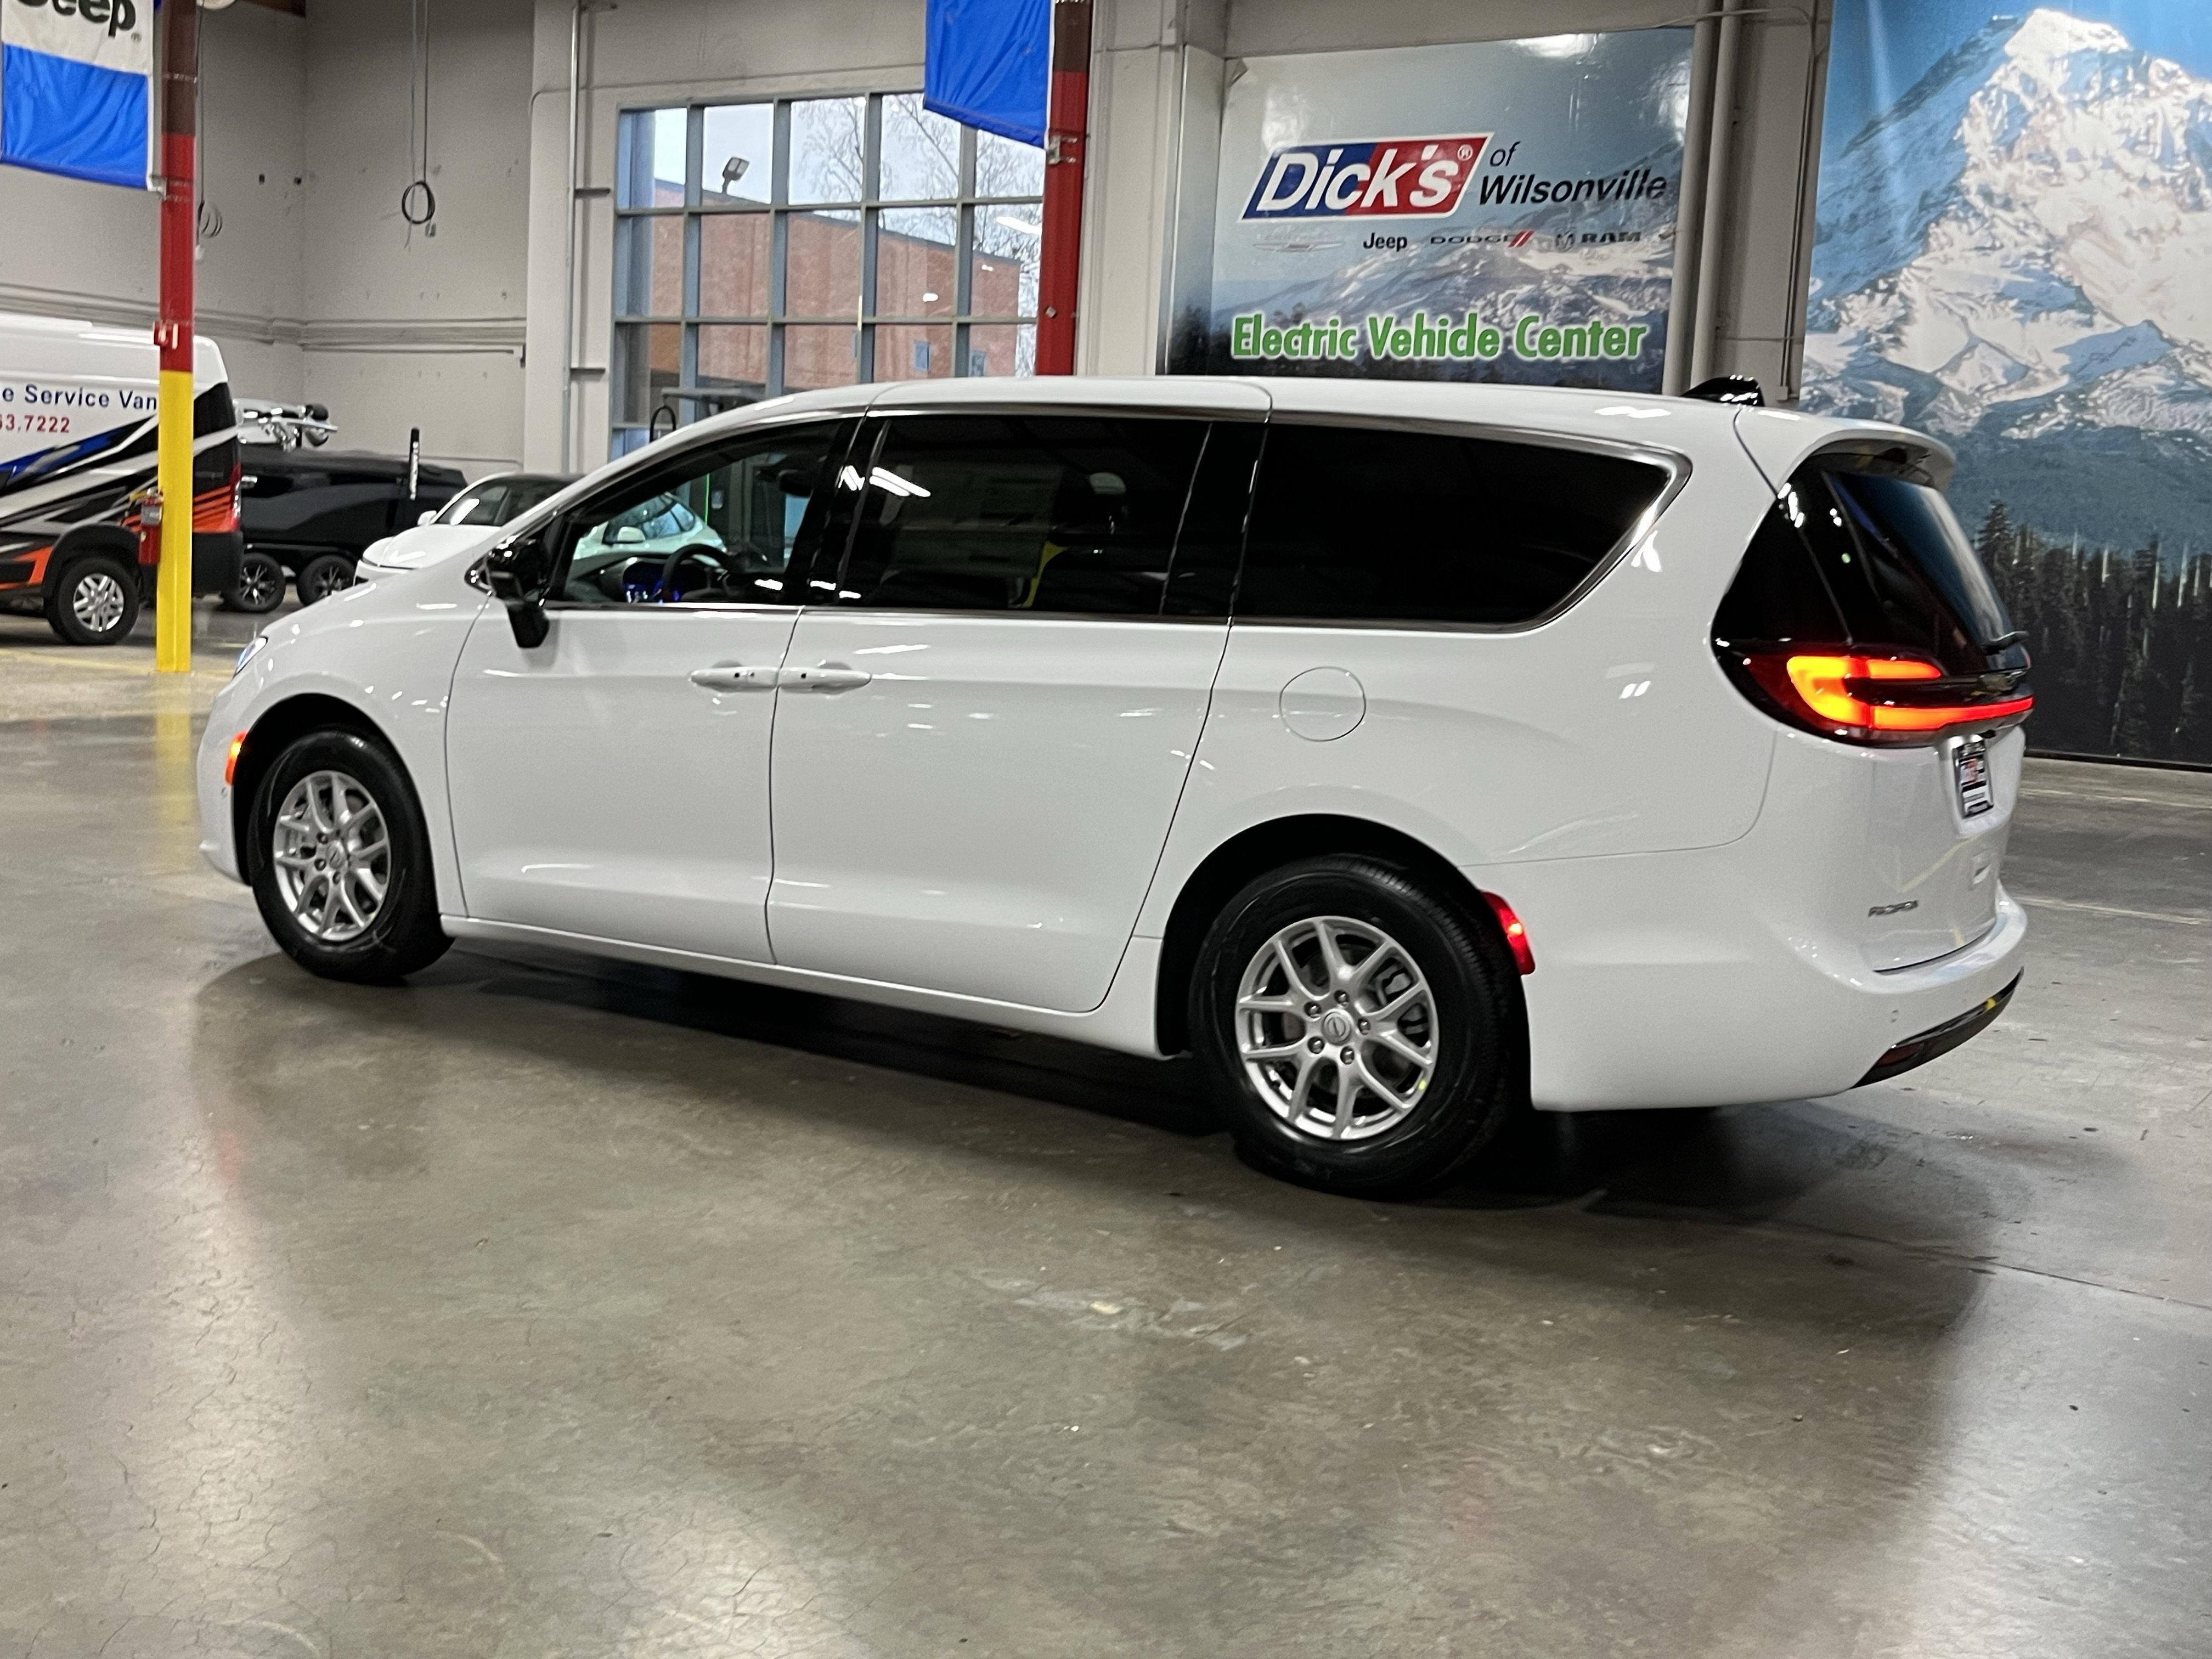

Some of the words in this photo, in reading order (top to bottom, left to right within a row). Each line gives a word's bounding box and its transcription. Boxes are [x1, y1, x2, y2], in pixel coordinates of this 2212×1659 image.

[17, 0, 136, 38] eep
[1489, 141, 1521, 167] of
[1256, 144, 1459, 213] Dick's
[1480, 168, 1668, 205] Wilsonville
[1363, 232, 1408, 252] Jeep
[1581, 232, 1642, 243] RAM
[1233, 313, 1357, 357] Electric
[1369, 312, 1500, 358] Vehicle
[1515, 315, 1647, 358] Center
[25, 384, 110, 408] Service
[119, 390, 157, 410] Van
